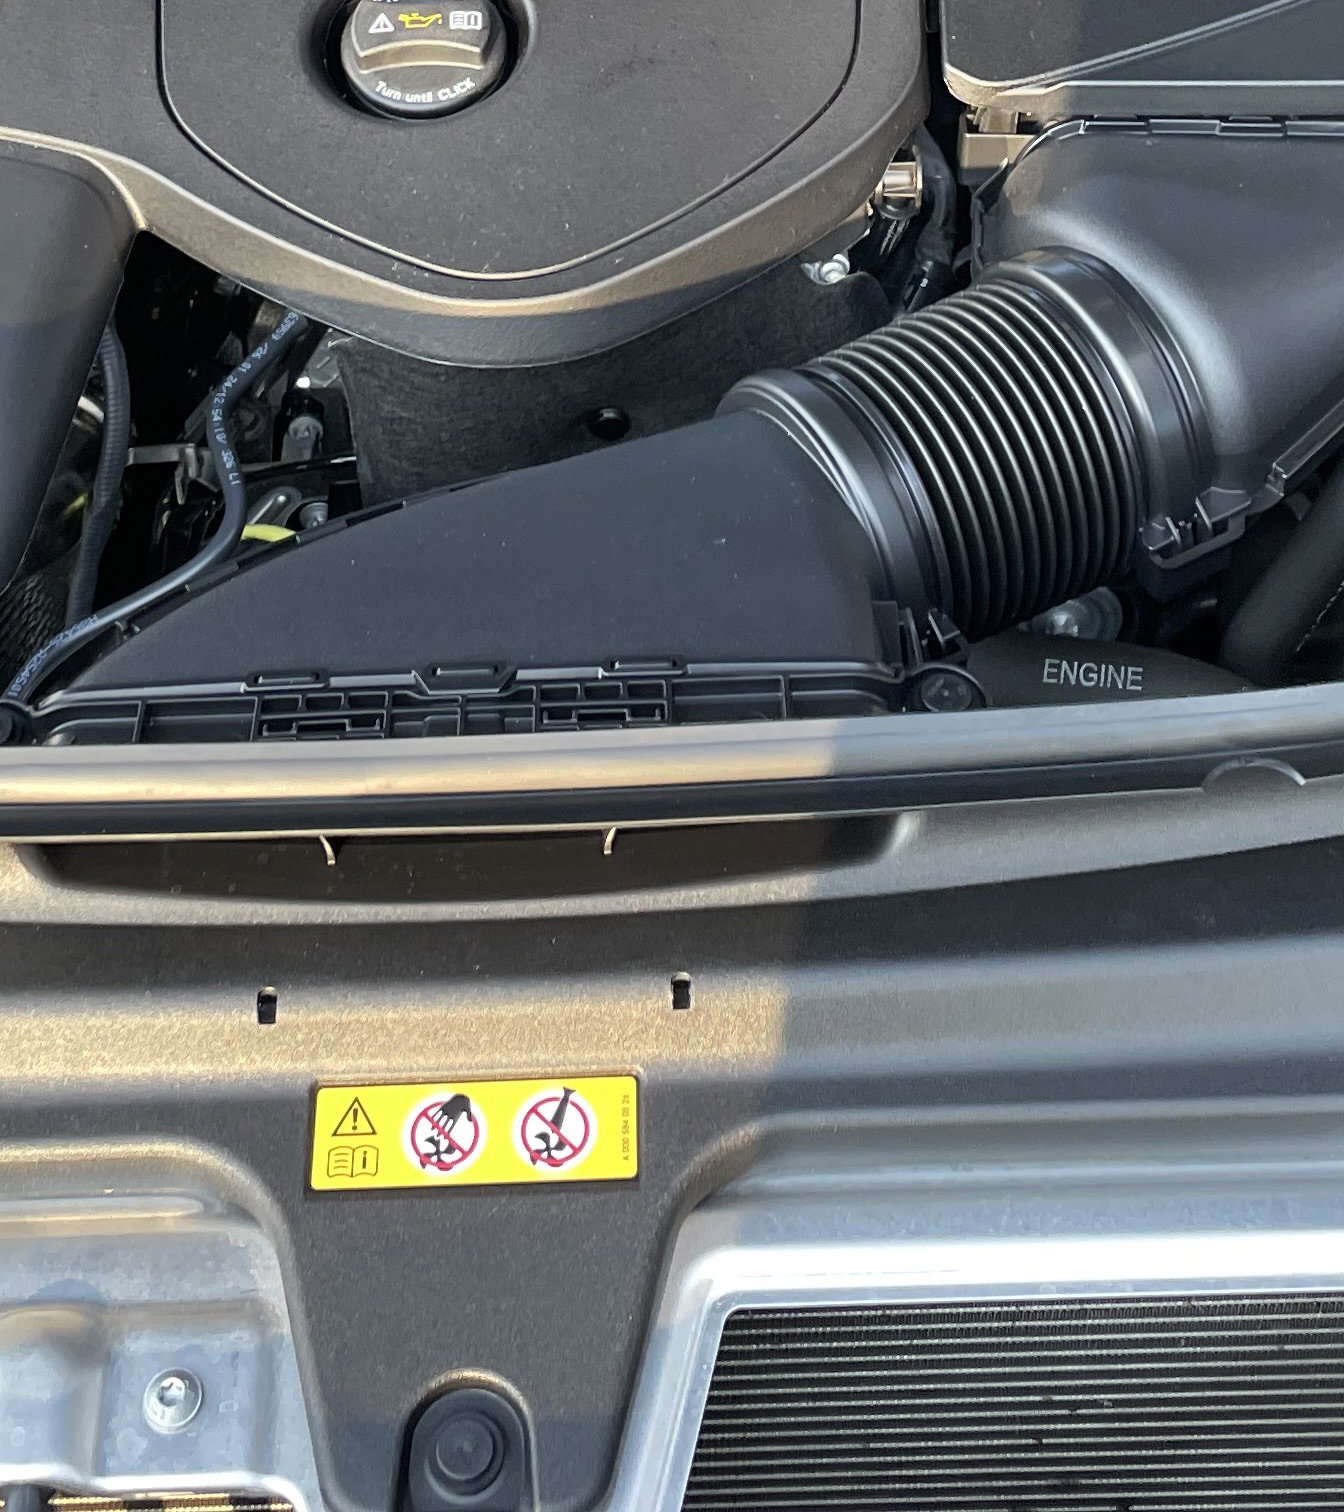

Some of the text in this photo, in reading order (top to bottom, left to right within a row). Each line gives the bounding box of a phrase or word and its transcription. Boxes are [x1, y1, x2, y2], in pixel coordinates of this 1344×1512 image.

[375, 77, 477, 103] Turn until CLICK
[1042, 658, 1144, 691] ENGINE
